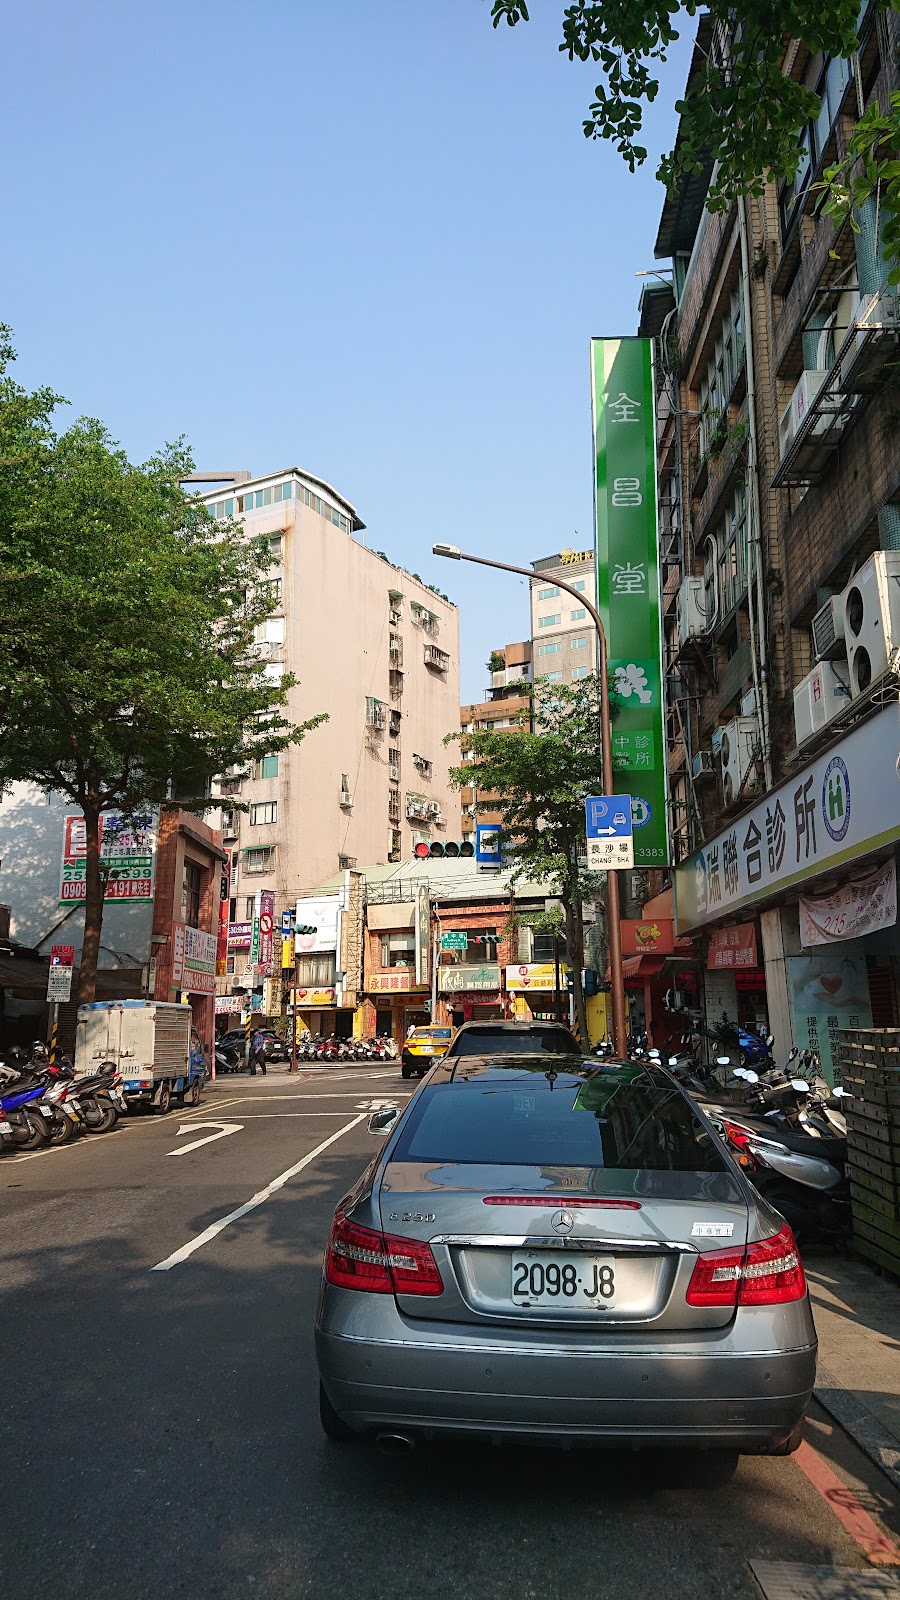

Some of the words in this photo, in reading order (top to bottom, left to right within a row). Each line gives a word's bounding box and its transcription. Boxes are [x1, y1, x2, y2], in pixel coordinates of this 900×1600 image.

[608, 392, 646, 594] 全昌堂
[590, 801, 609, 827] P
[591, 843, 628, 853] 長沙場
[402, 1212, 436, 1222] 250
